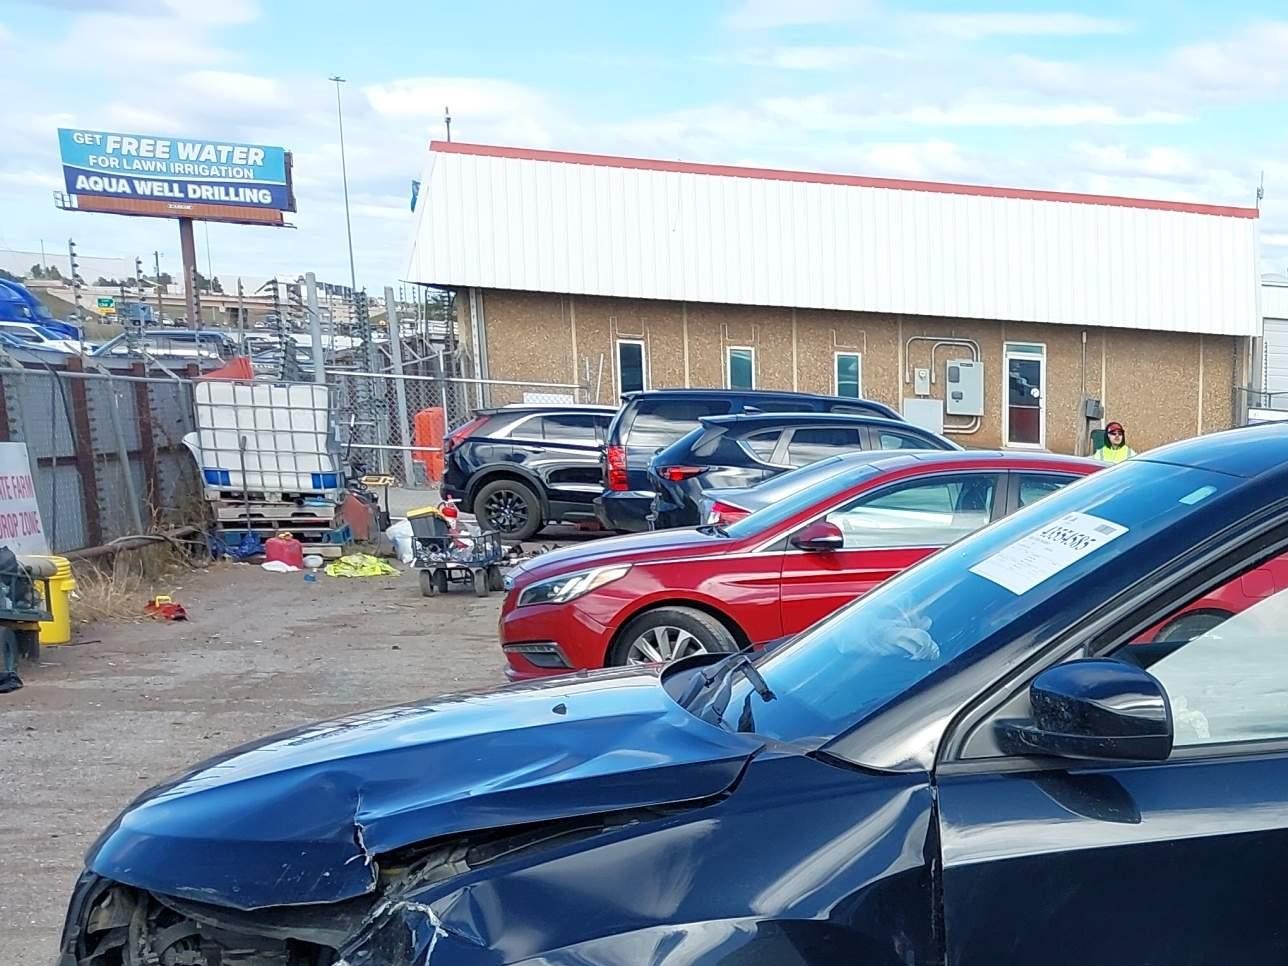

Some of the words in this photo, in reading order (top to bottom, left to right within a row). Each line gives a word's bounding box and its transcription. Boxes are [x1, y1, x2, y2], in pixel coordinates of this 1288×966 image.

[73, 133, 102, 146] GET
[106, 135, 171, 159] FREE
[177, 141, 265, 166] WATER
[88, 155, 120, 169] FOR
[122, 158, 167, 173] LAWN
[170, 162, 254, 179] IRRIGATION
[75, 175, 132, 194] AQUA
[132, 179, 184, 198] WELL
[187, 183, 273, 204] DRILLING
[11, 474, 34, 499] FARM
[19, 511, 41, 537] ZONE
